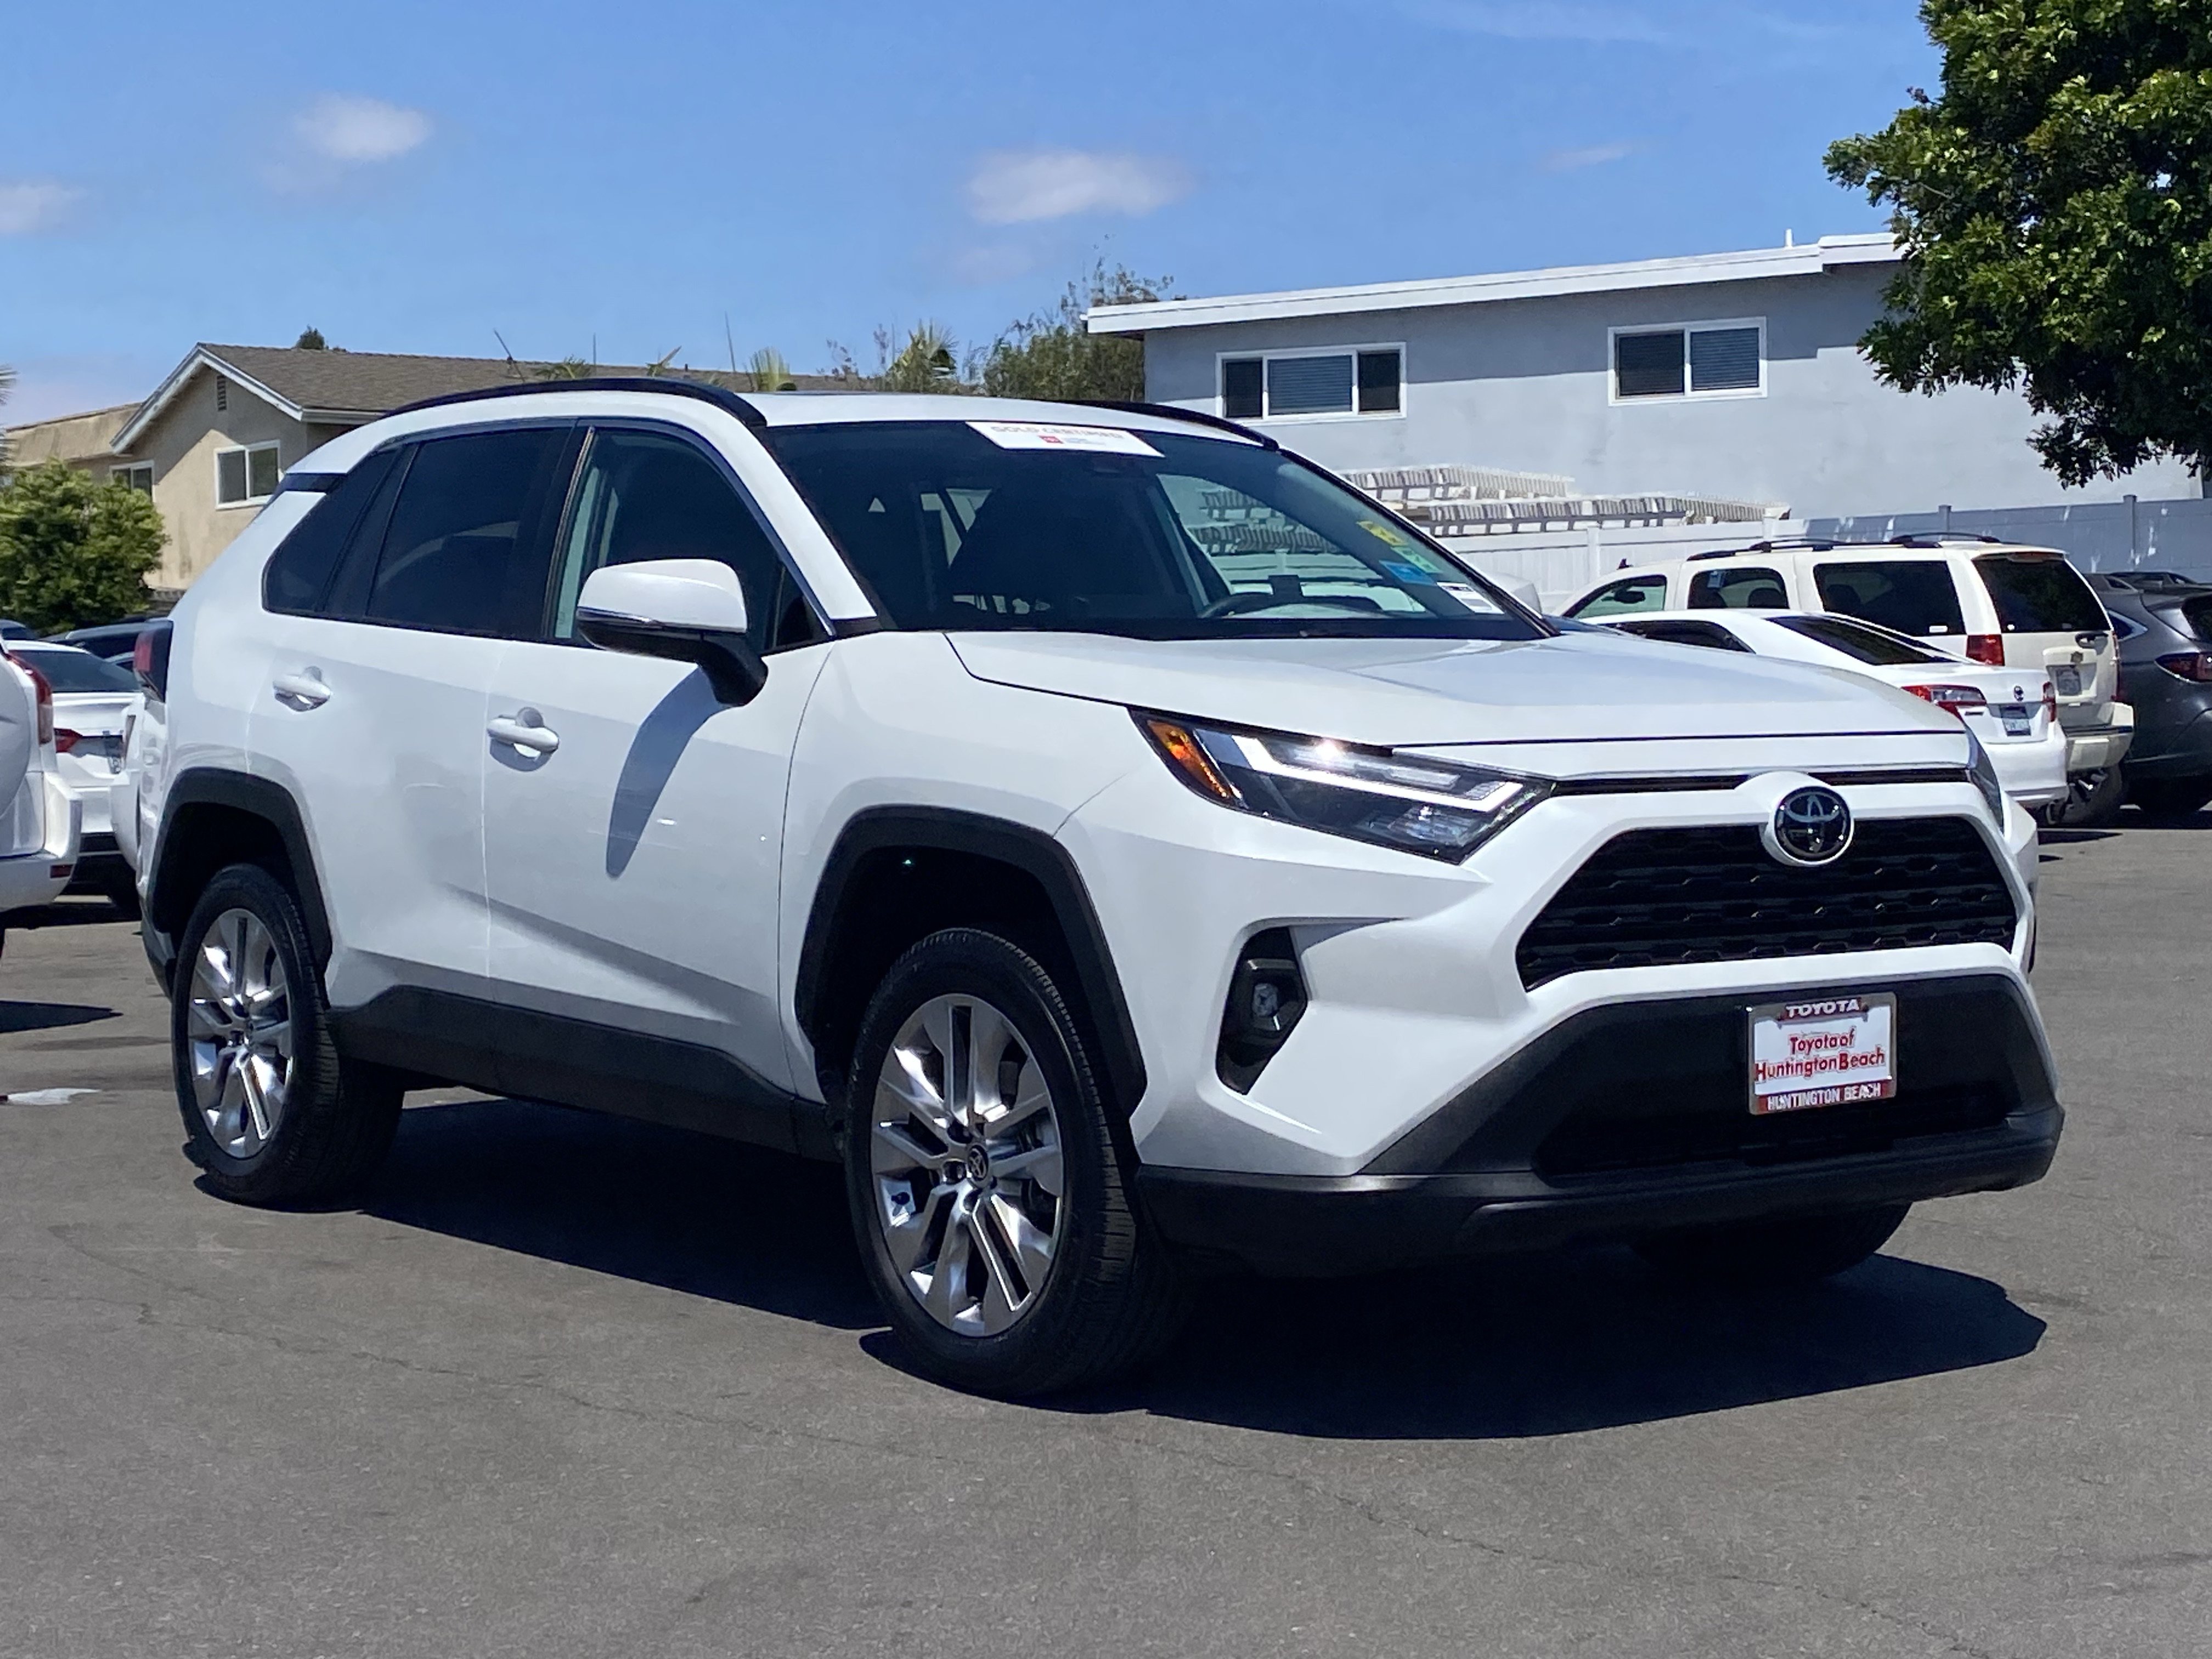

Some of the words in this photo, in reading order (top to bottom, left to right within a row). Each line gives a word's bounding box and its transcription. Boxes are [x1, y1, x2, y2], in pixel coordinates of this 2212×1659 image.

[1786, 998, 1860, 1018] TOYOTA
[1790, 1034, 1838, 1055] Toyota
[1839, 1027, 1855, 1047] of
[1756, 1057, 1837, 1081] Huntington
[1838, 1047, 1885, 1070] Beach
[1768, 1087, 1840, 1111] HUNTINGTON
[1844, 1082, 1881, 1101] BEACH
